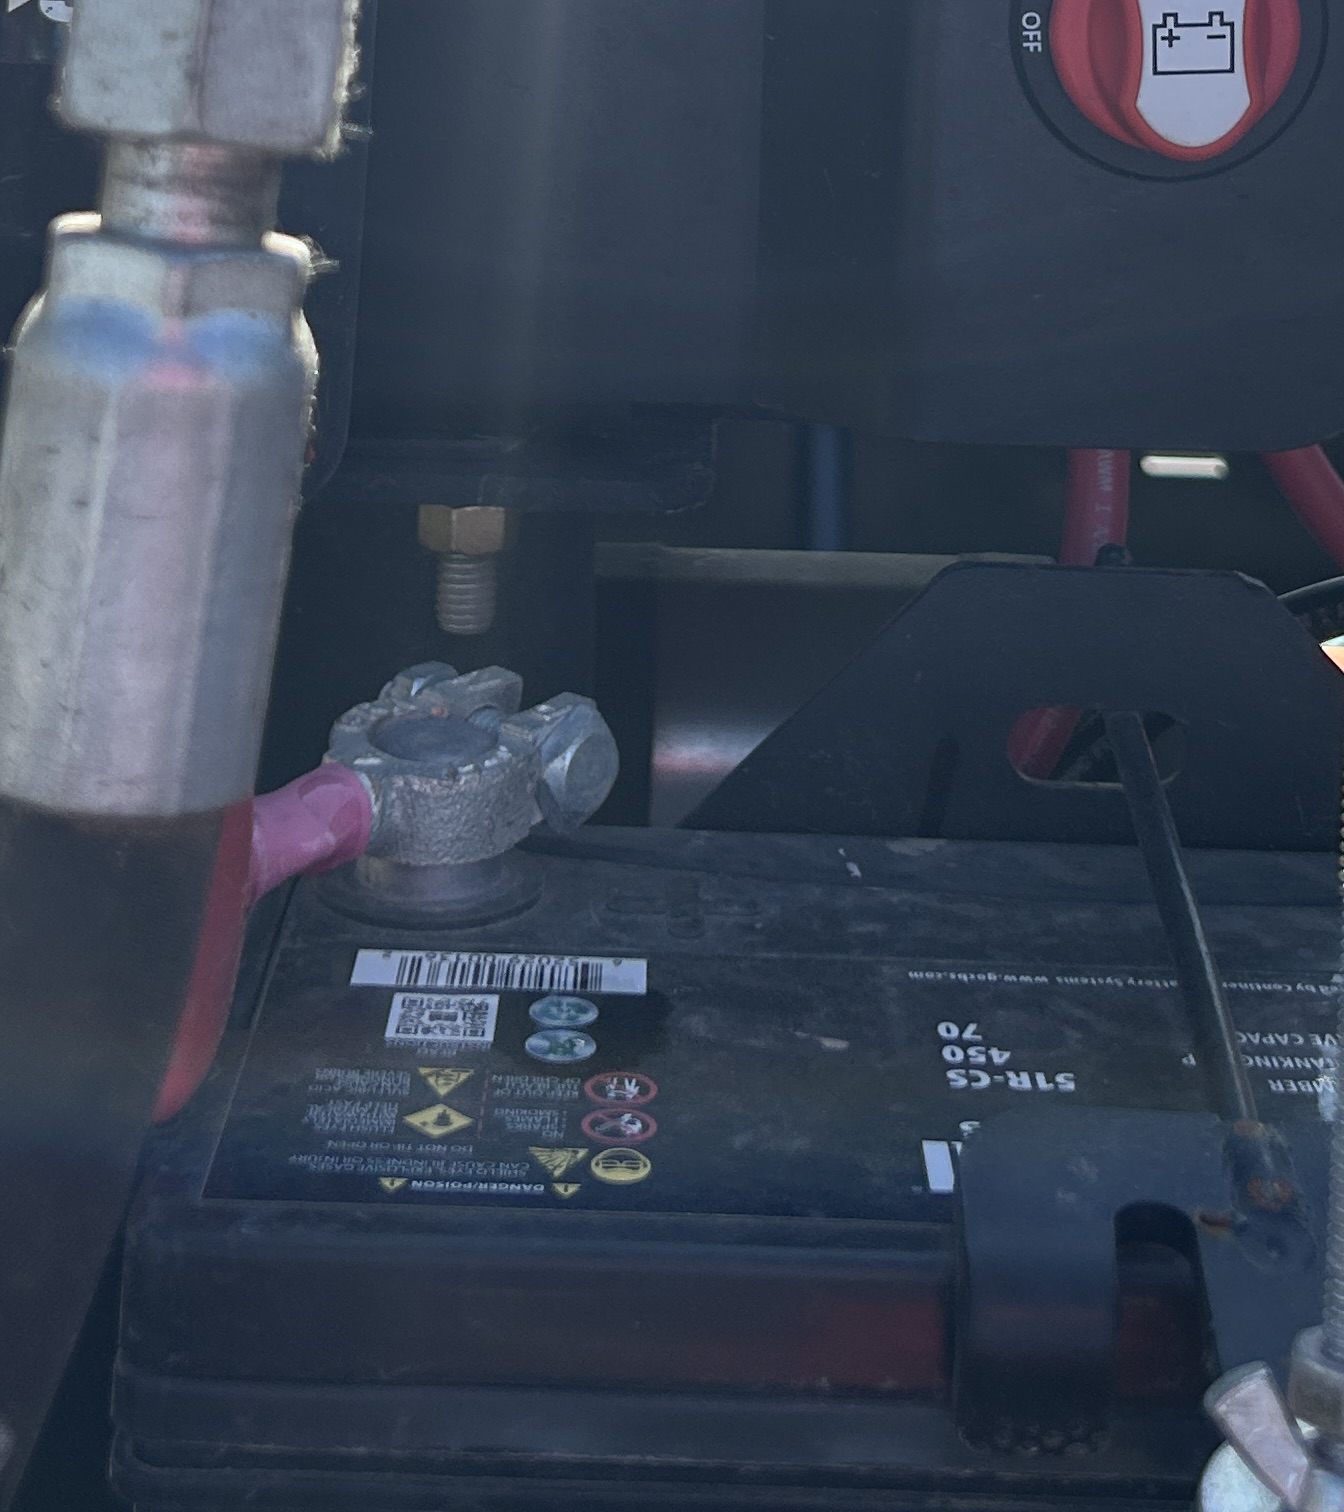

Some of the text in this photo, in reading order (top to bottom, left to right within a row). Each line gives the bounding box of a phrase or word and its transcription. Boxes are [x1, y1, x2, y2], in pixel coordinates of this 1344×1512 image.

[1021, 11, 1042, 53] OFF
[1056, 975, 1124, 988] Systems
[1127, 977, 1179, 988] attery
[1222, 981, 1292, 993] Contine
[937, 1021, 982, 1041] 70
[1237, 1031, 1341, 1046] VE CAPAC
[941, 1044, 1010, 1066] 450
[1240, 1054, 1336, 1072] ANKING
[945, 1068, 1076, 1092] 51R-CS
[1268, 1078, 1336, 1094] MBER
[410, 1179, 545, 1192] DANGER/POISON
